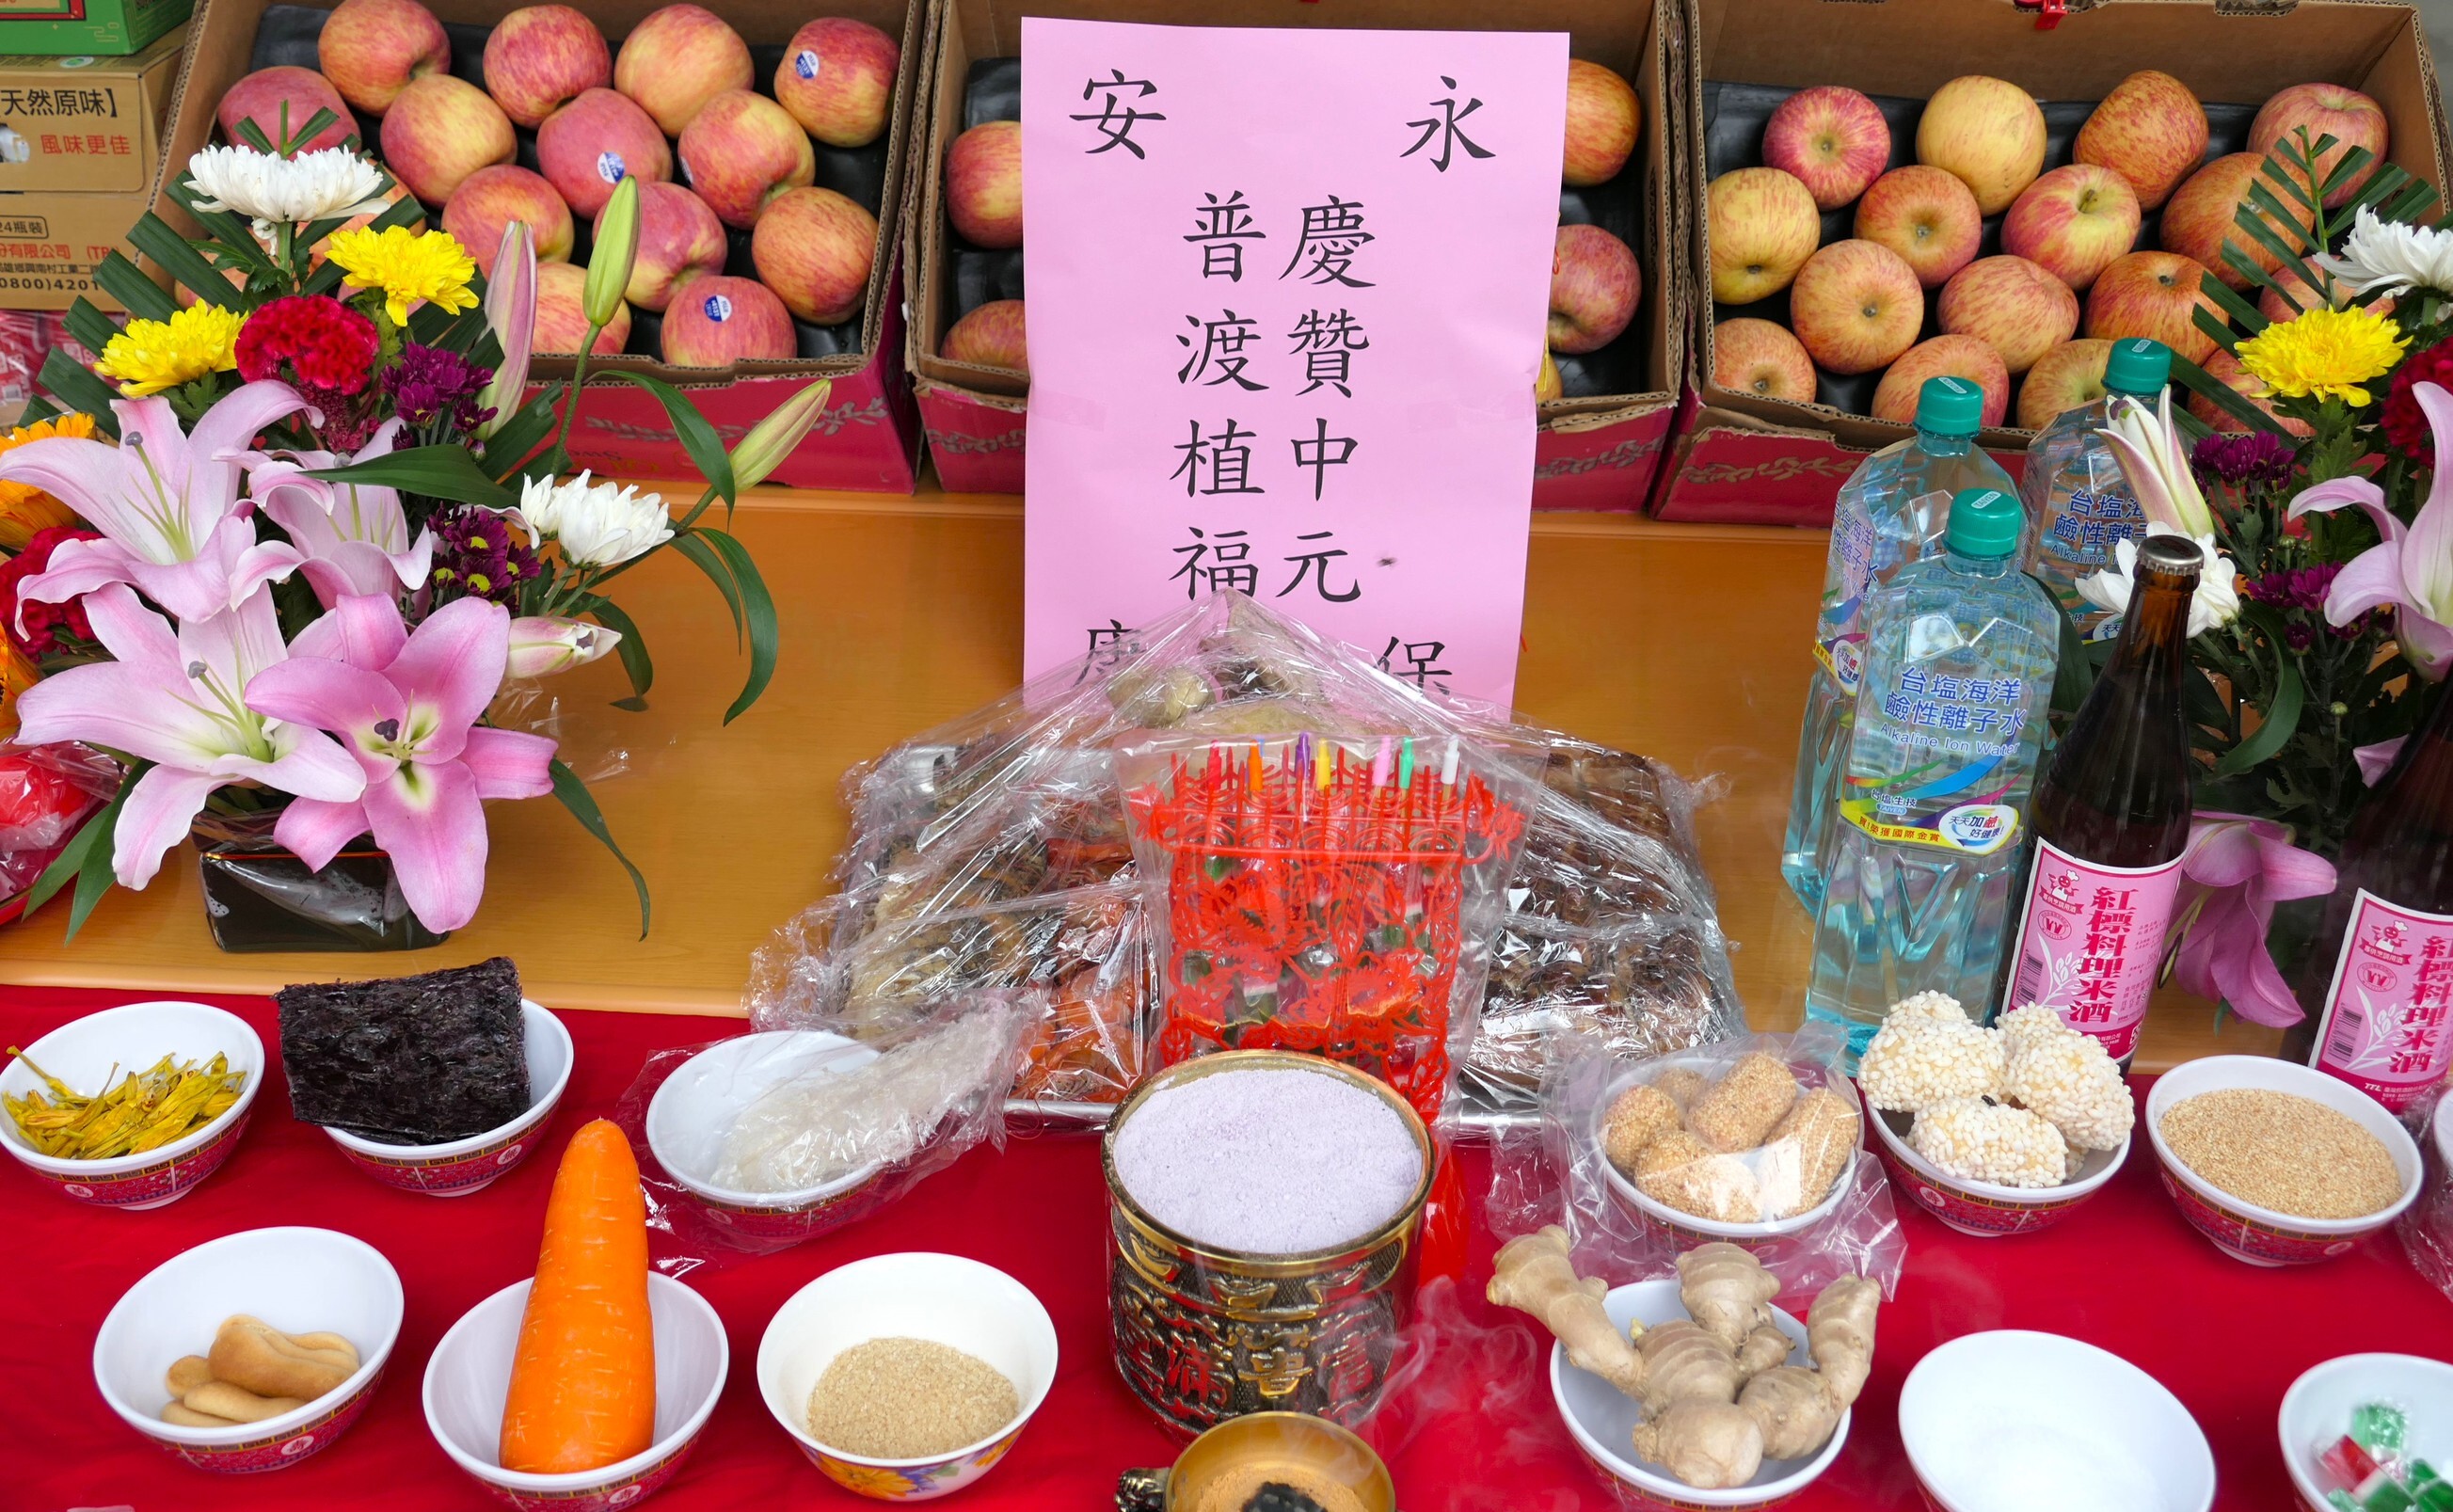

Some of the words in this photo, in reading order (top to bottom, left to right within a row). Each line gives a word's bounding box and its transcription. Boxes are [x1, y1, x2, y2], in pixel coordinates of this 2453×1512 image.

[1069, 69, 1167, 160] 安
[1399, 75, 1496, 173] 永
[40, 135, 132, 155] 風味更佳
[1169, 190, 1269, 601] 普渡植福
[2050, 544, 2107, 565] Alkaline
[1373, 636, 1453, 697] 保
[1901, 666, 2021, 706] 台塩海洋
[1884, 692, 2027, 736] 鹼性離子水
[1880, 724, 1939, 747] Alkaline
[1945, 738, 1969, 751] Ion
[1977, 741, 2020, 756] Water
[1878, 804, 1904, 814] TAIYEN
[2068, 886, 2139, 1024] 紅標料理米酒
